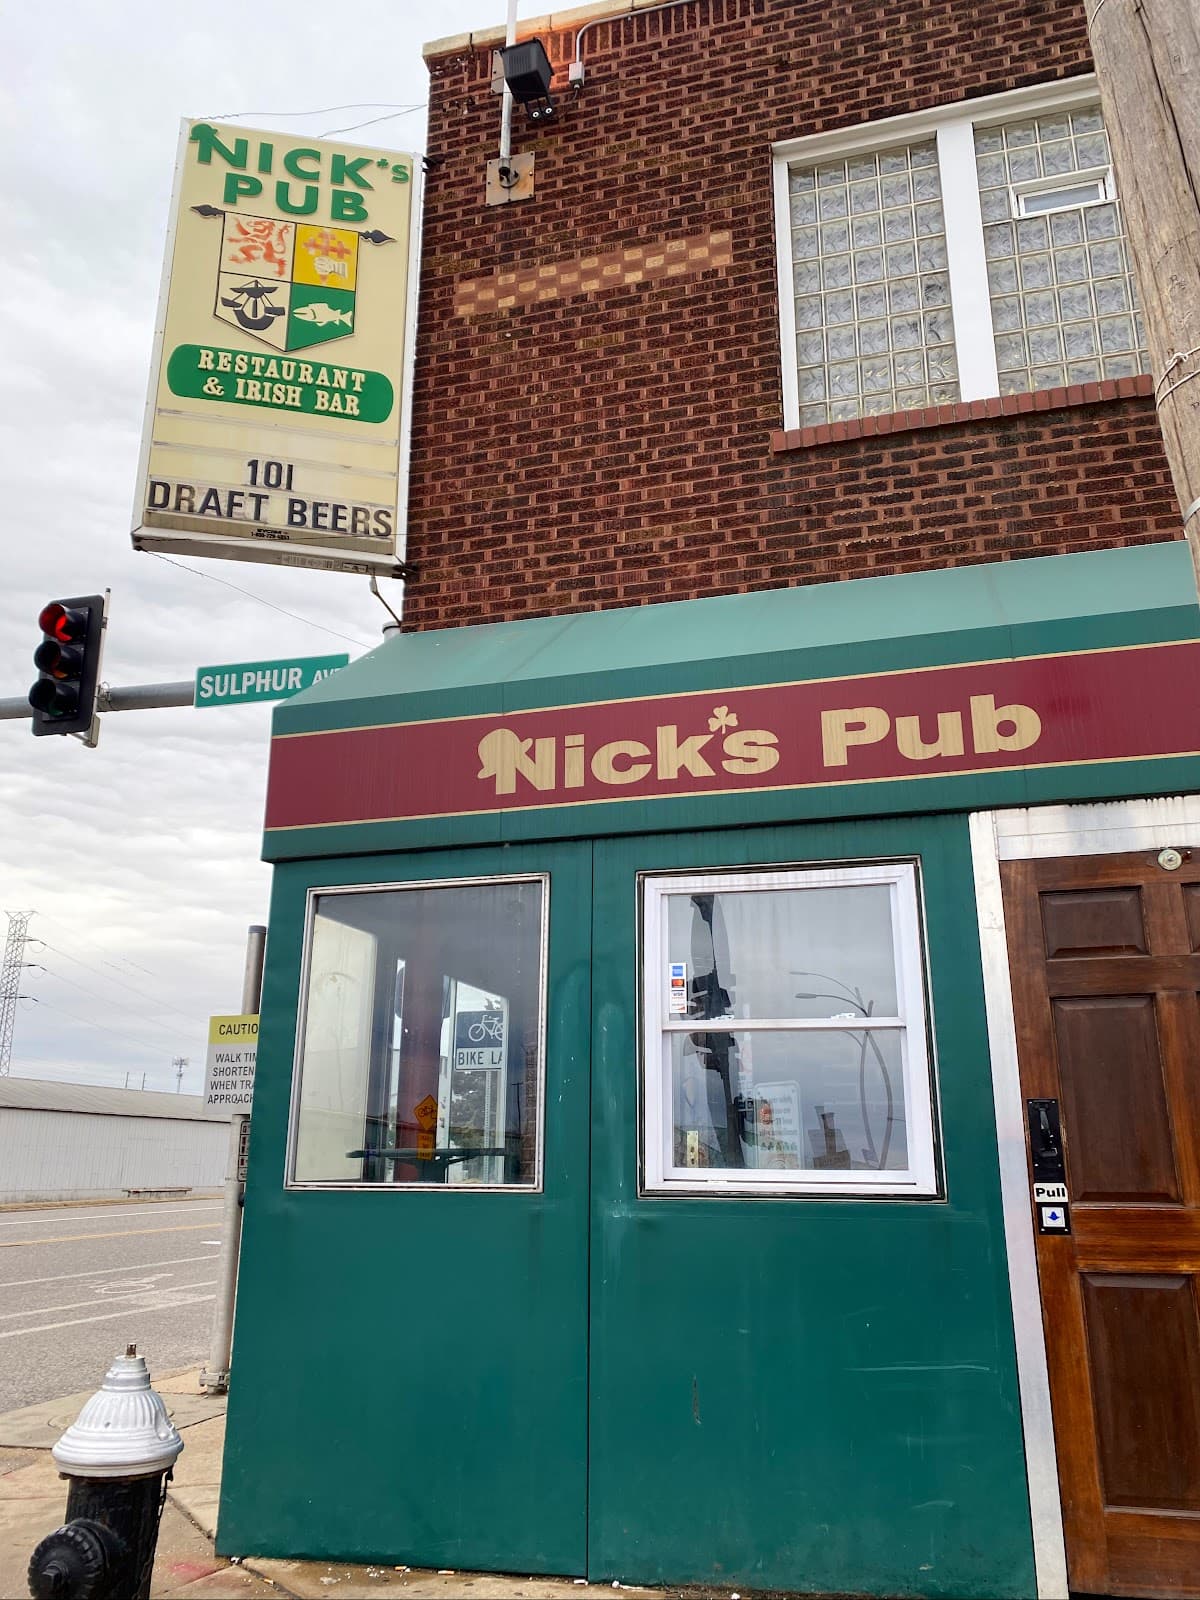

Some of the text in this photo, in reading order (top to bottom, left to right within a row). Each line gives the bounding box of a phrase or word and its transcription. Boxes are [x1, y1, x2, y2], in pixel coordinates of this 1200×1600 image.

[223, 172, 369, 222] PUB
[197, 349, 366, 393] RESTAURANT
[202, 376, 360, 417] & IRISH BAR
[149, 480, 392, 538] DRAFT BEERS
[200, 667, 302, 699] SULPHUR
[821, 694, 1042, 767] Pub
[215, 1053, 241, 1063] WALK
[458, 1051, 484, 1066] BIKE
[210, 1080, 237, 1090] WHEN
[1035, 1187, 1066, 1198] Pull
